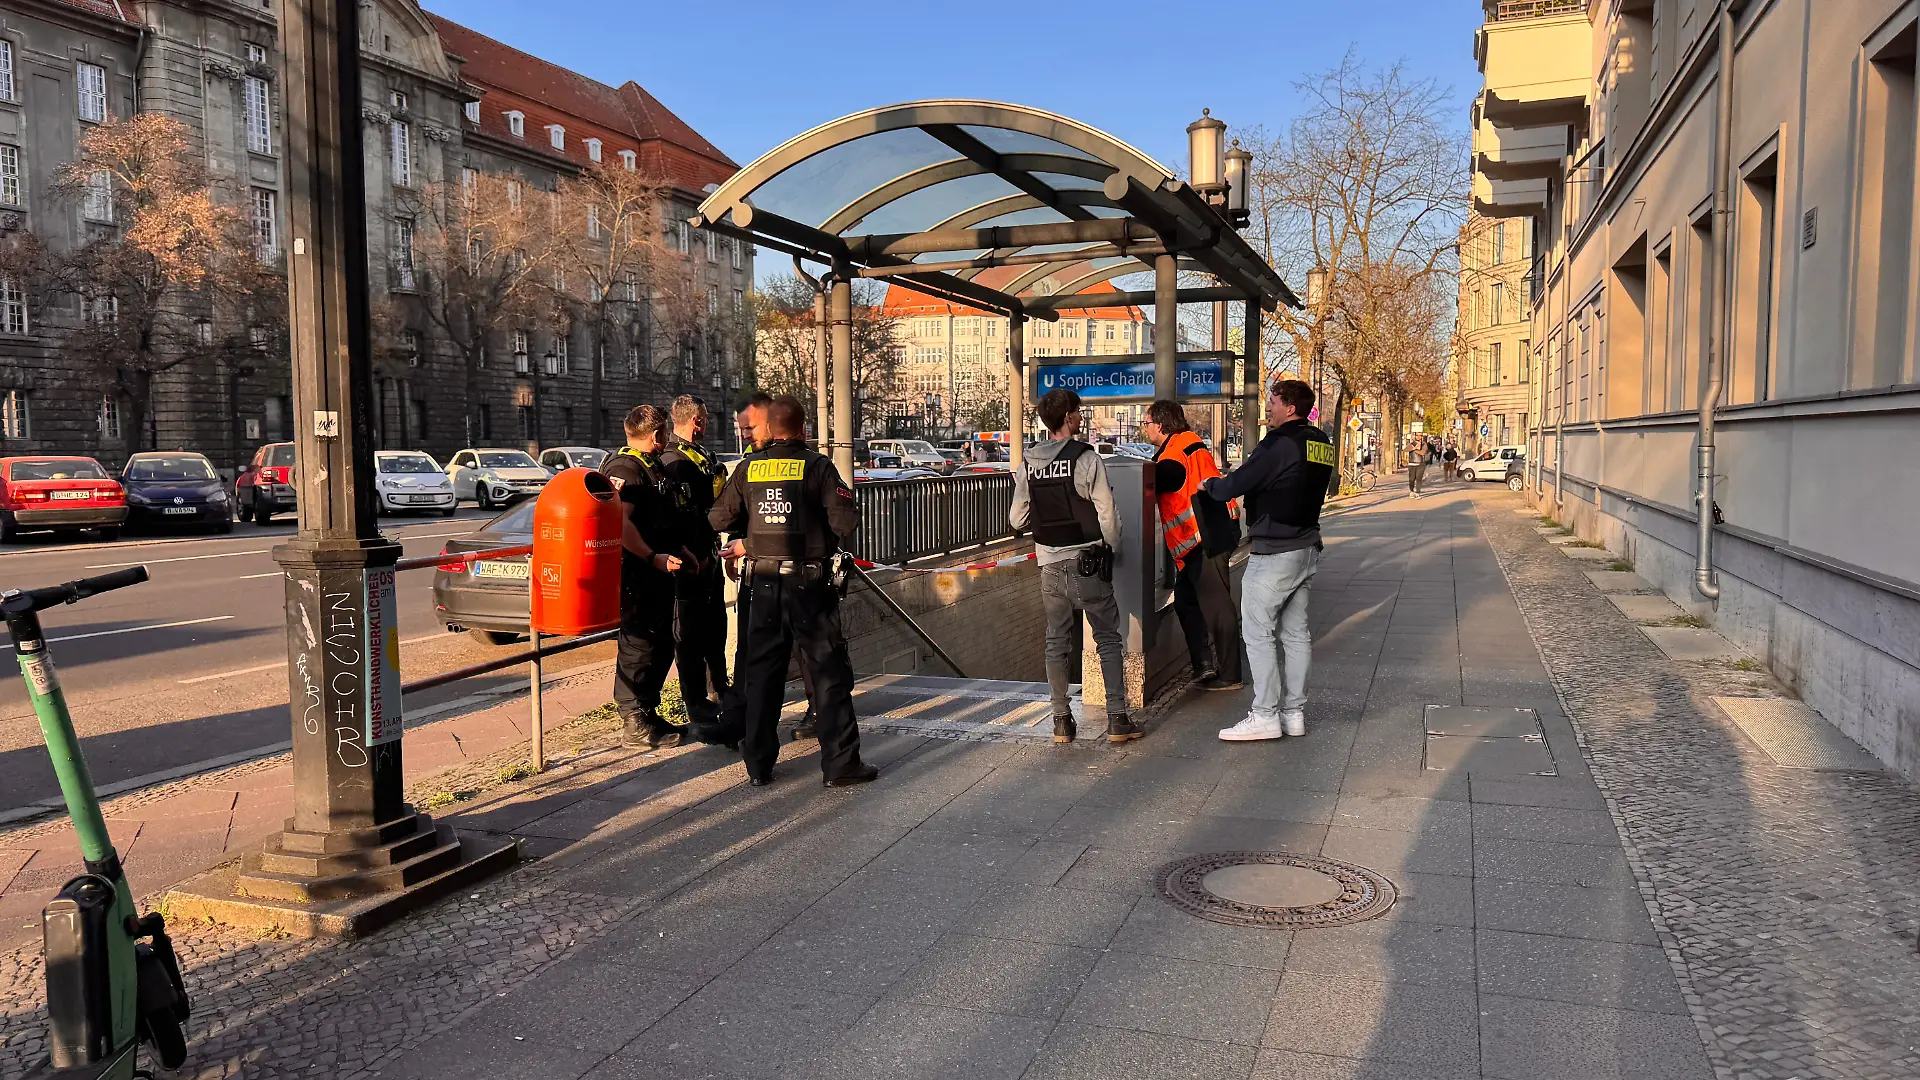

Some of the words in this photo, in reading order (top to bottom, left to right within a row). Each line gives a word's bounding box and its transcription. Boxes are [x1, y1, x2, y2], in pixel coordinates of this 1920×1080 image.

[1044, 374, 1054, 388] U
[1059, 369, 1215, 390] Sophie-Charlo-Platz
[750, 461, 802, 478] POLIZEI
[1027, 459, 1071, 481] POLIZEI
[766, 488, 783, 500] BE
[758, 501, 792, 514] 25300
[511, 565, 528, 576] 979
[543, 567, 559, 583] BSR
[368, 572, 382, 740] KUNSTHANDWERKLICHER
